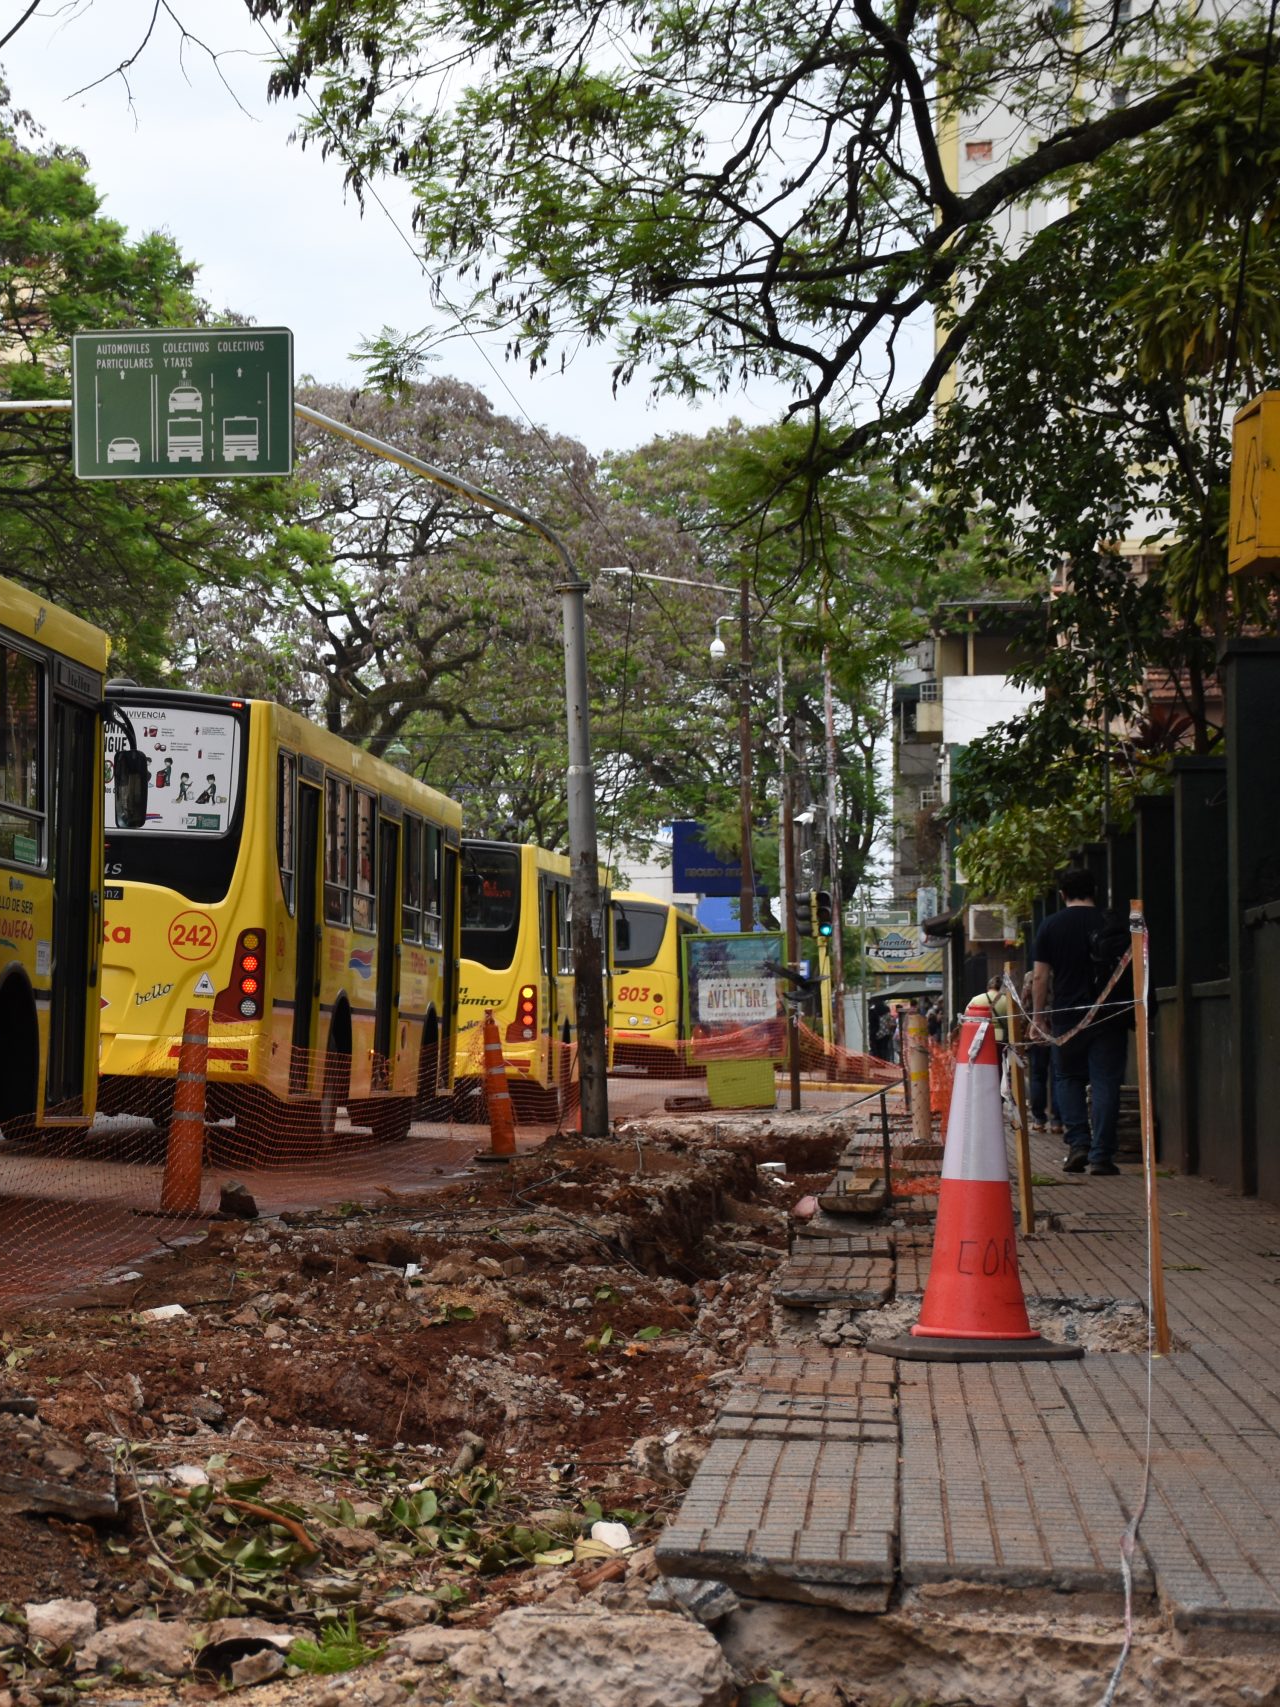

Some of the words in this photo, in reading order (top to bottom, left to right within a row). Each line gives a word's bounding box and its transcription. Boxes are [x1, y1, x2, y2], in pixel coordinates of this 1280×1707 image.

[96, 342, 150, 355] AUTOMOVILES
[162, 341, 210, 353] COLECTIVOS
[217, 340, 265, 352] COLECTIVOS
[96, 357, 154, 370] PARTICULARES
[163, 358, 169, 368] Y
[170, 357, 193, 368] TAXIS
[11, 898, 20, 912] DE
[21, 900, 34, 915] SER
[172, 924, 212, 947] 242
[868, 948, 921, 958] EXPRESS
[135, 981, 174, 1007] bello
[617, 986, 652, 1003] 803
[706, 987, 769, 1010] AVENTURA
